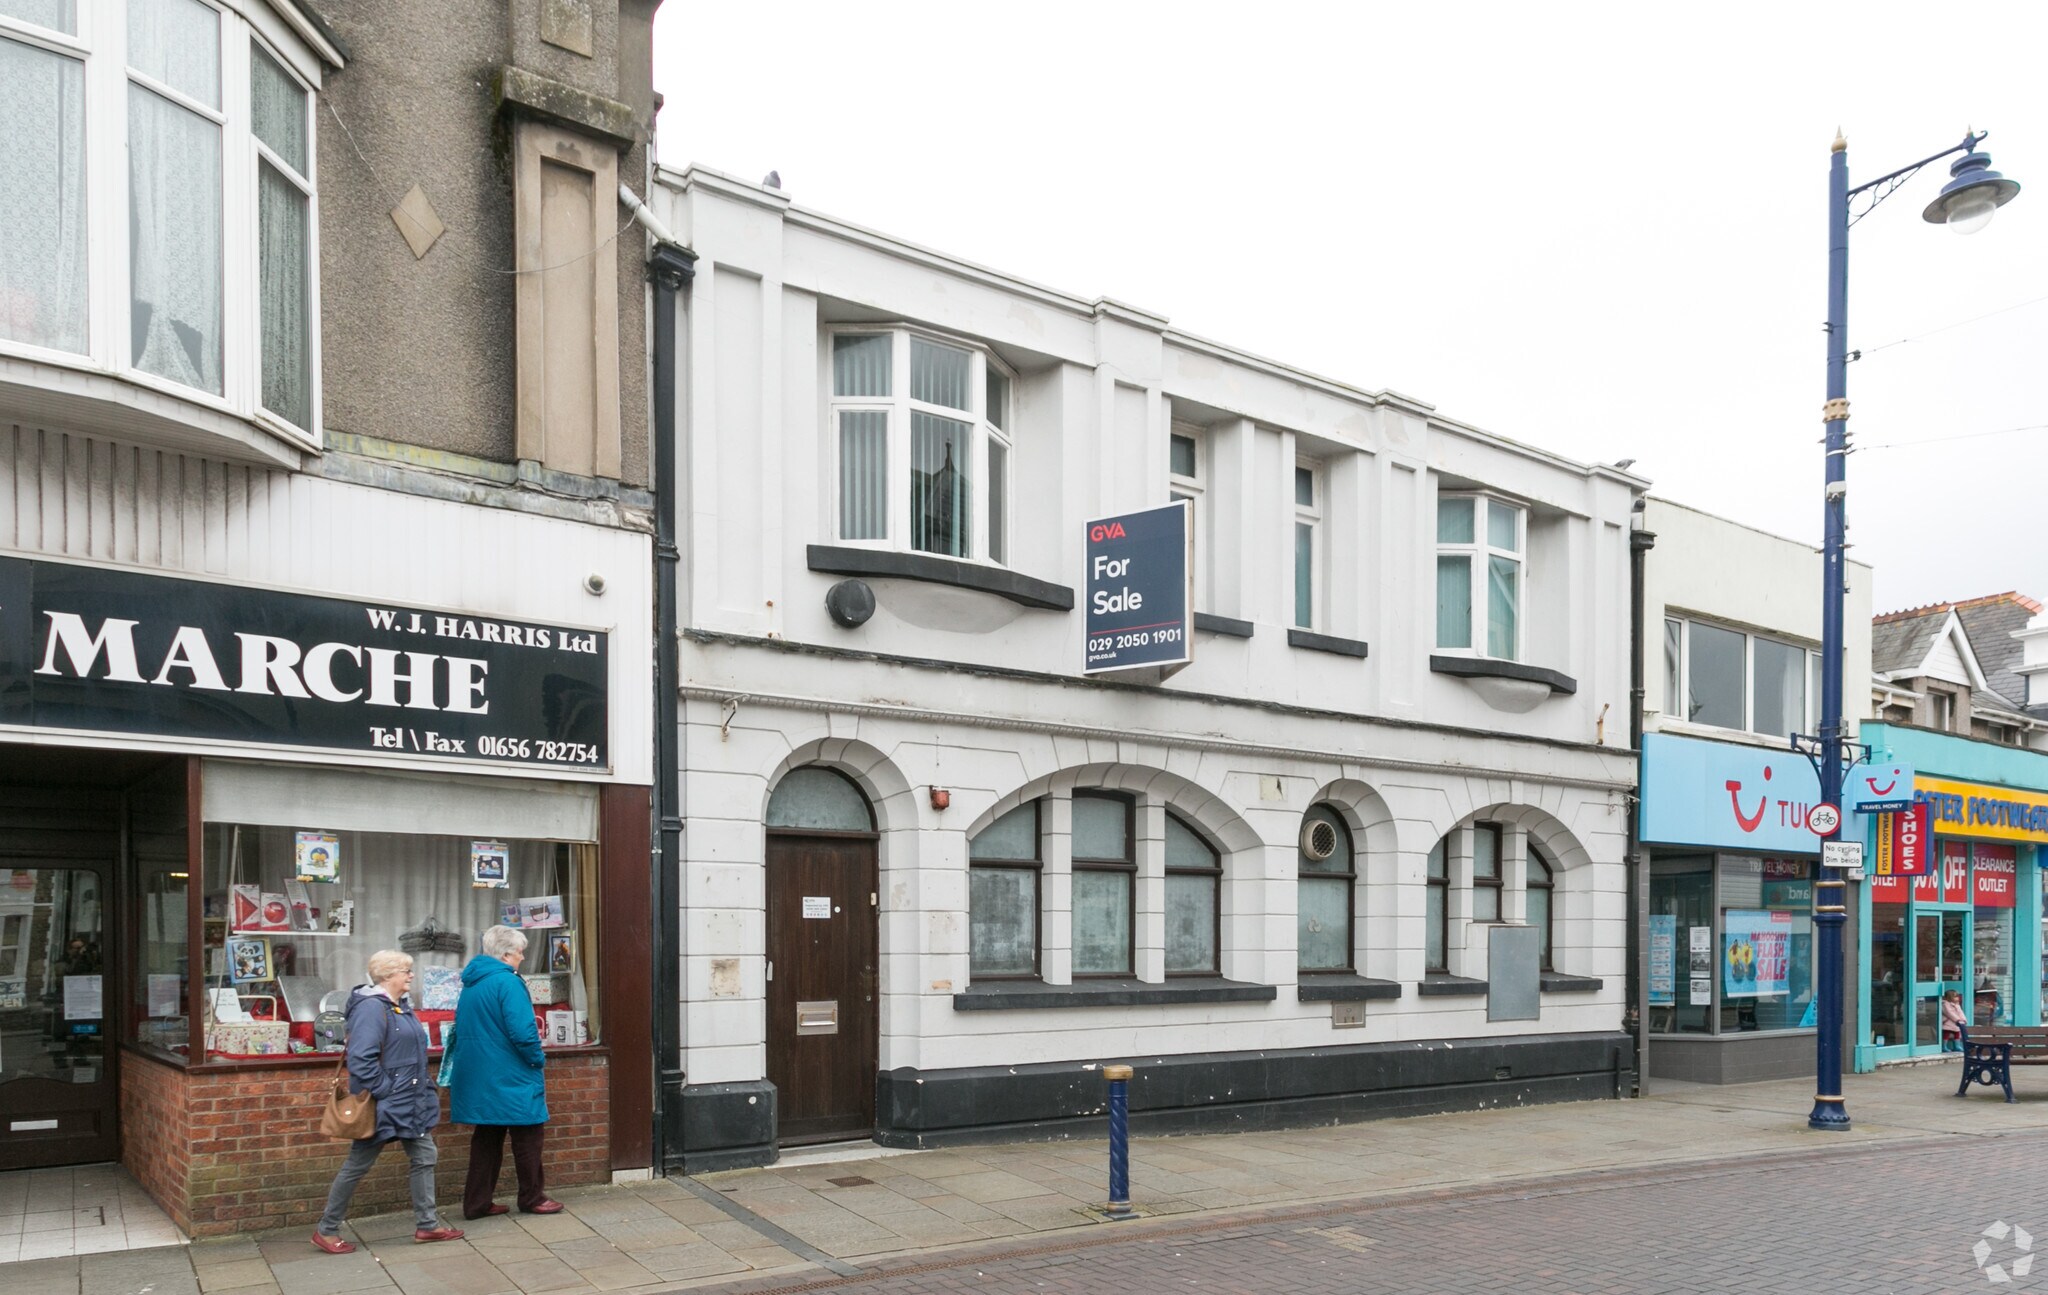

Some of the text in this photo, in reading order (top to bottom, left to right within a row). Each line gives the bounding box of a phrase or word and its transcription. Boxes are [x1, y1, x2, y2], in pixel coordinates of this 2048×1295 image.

[1090, 522, 1126, 542] GVA
[1094, 555, 1130, 580] For
[1093, 586, 1143, 615] Sale
[366, 608, 598, 655] W. J. HARRIS Ltd
[1088, 628, 1182, 652] 029 2050 1901
[34, 610, 489, 715] MARCHE
[1088, 651, 1117, 663] gva.co.uk
[370, 726, 404, 748] Tel
[425, 731, 466, 753] Fax
[478, 735, 531, 758] 01656
[535, 740, 599, 763] 782754
[1777, 799, 1808, 829] TUI
[1968, 796, 2048, 833] FOOTWEAR
[1837, 845, 1860, 854] cycling
[1901, 810, 1917, 870] SHOES
[1749, 861, 1775, 873] TRAVEL
[1840, 856, 1859, 864] beicio
[1973, 856, 2015, 873] CLEARANCE
[1944, 855, 1966, 890] OFF
[1979, 877, 2008, 893] OUTLET
[1757, 942, 1785, 958] FLASH
[1757, 959, 1787, 981] SALE
